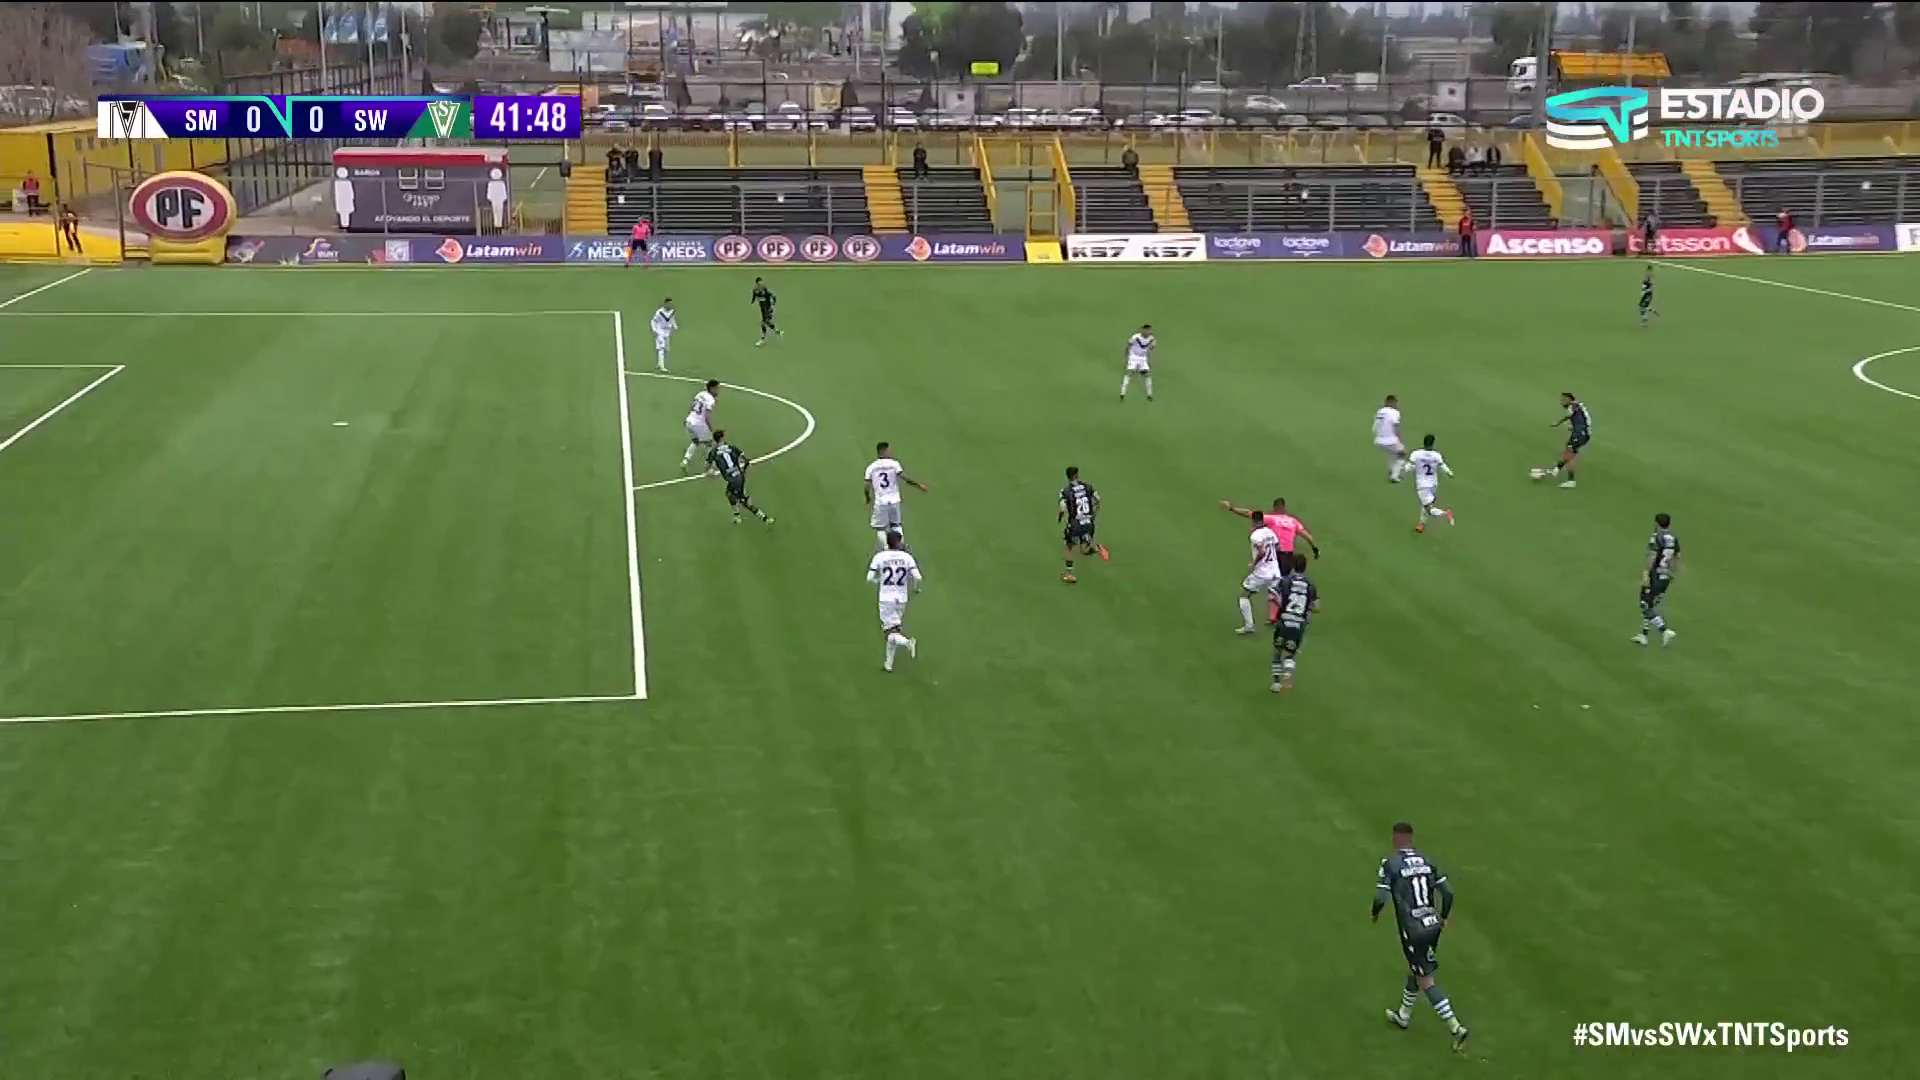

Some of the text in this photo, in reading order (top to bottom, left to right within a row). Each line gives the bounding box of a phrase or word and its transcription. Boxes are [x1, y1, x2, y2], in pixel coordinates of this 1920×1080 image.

[155, 188, 205, 229] PF
[466, 243, 542, 258] Latamwin
[723, 242, 742, 257] PF
[766, 242, 785, 257] PF
[810, 242, 828, 257] PF
[853, 242, 871, 257] PF
[933, 242, 1006, 256] Latamwin
[1389, 240, 1460, 252] Latamwin
[1486, 233, 1605, 254] Ascenso
[587, 246, 624, 259] MED
[662, 246, 706, 259] MEDS
[1422, 464, 1434, 476] 2
[879, 472, 890, 488] 3
[882, 566, 907, 586] 22
[1411, 875, 1430, 907] 11
